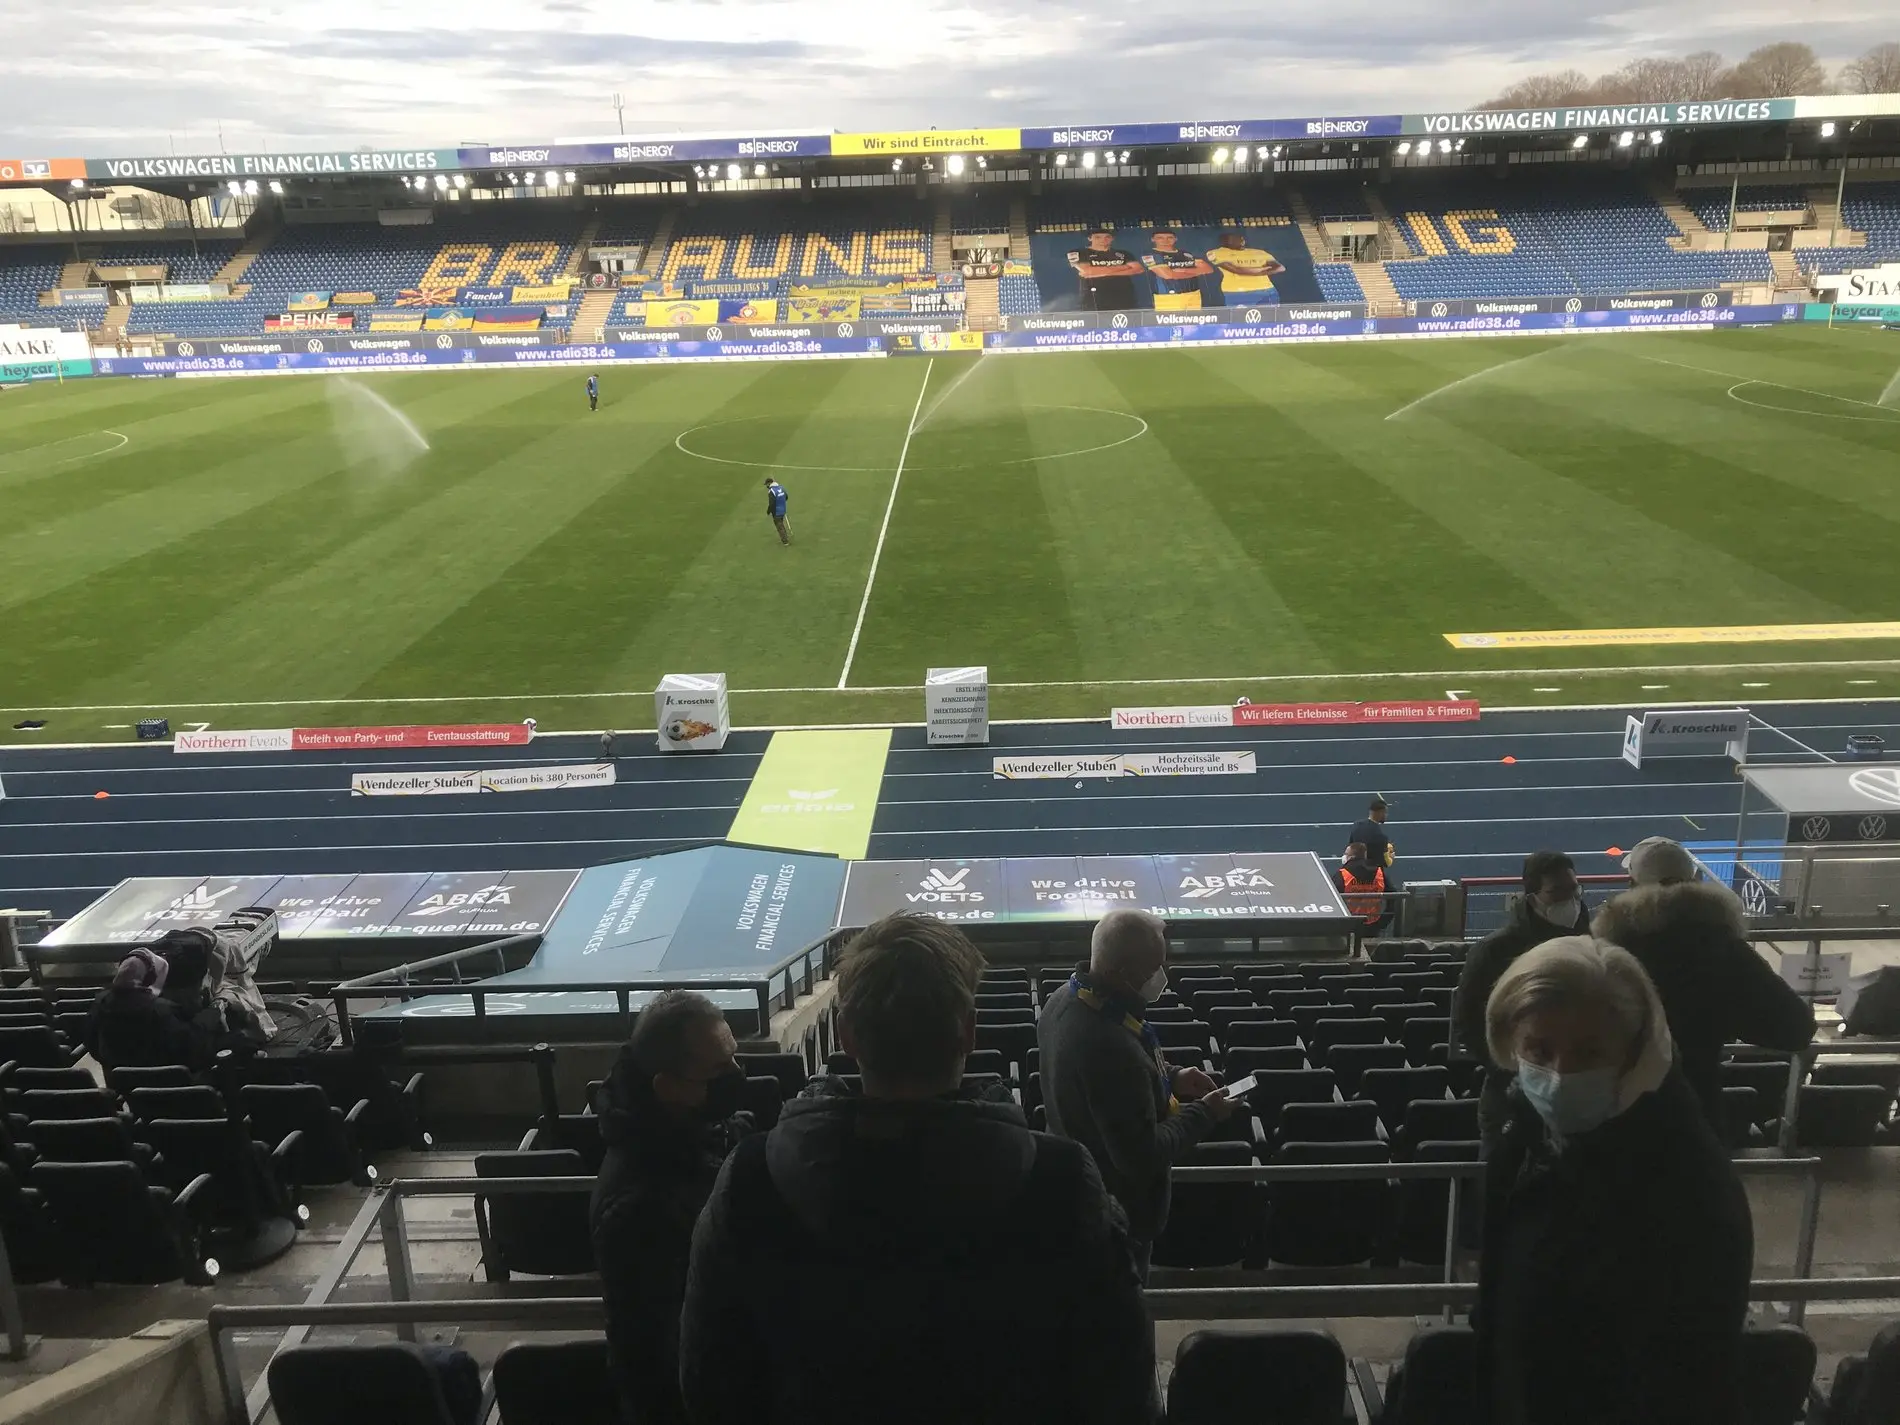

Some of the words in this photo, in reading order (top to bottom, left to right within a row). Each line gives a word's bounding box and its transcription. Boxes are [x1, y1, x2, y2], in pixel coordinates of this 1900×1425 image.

[1423, 111, 1556, 132] VOLKSWAGEN
[1564, 106, 1670, 127] FINANCIAL
[1676, 101, 1771, 122] SERVICES
[863, 137, 886, 149] Wir
[891, 136, 918, 148] sind
[924, 135, 988, 147] Eintracht.
[106, 157, 236, 177] VOLKSWAGEN
[243, 154, 344, 173] FINANCIAL
[350, 151, 437, 170] SERVICES
[465, 291, 504, 300] Fanclub
[911, 294, 941, 304] Unser
[1476, 302, 1537, 314] Volkswagen
[1611, 299, 1673, 310] Volkswagen
[280, 313, 338, 326] PEINE
[1156, 314, 1217, 325] Volkswagen
[1290, 309, 1351, 320] Volkswagen
[1630, 309, 1735, 324] www.radio38.de
[881, 323, 941, 335] Volkswagen
[1024, 318, 1084, 330] Volkswagen
[1418, 317, 1520, 331] www.radio38.de
[619, 331, 680, 342] Volkswagen
[750, 327, 810, 338] Volkswagen
[1036, 330, 1137, 344] www.radio38.de
[1224, 324, 1326, 338] www.radio38.de
[350, 339, 410, 350] Volkswagen
[479, 335, 540, 346] Volkswagen
[721, 340, 822, 354] www.radio38.de
[220, 343, 281, 354] Volkswagen
[515, 346, 616, 360] www.radio38.de
[143, 357, 244, 370] www.radio38.de
[327, 353, 427, 366] www.radio38.de
[1116, 711, 1185, 726] Northern
[1188, 709, 1228, 723] Events
[1241, 709, 1260, 720] Wir
[1262, 708, 1294, 720] liefern
[1297, 707, 1348, 719] Erlebnisse
[1364, 706, 1379, 717] für
[1381, 705, 1424, 717] Familien
[1426, 706, 1435, 716] &
[1438, 705, 1473, 716] Firmen
[179, 736, 246, 749] Northern
[250, 734, 288, 747] Events
[299, 734, 331, 744] Verleih
[334, 735, 351, 743] von
[354, 733, 382, 744] Party-
[385, 732, 404, 742] und
[427, 731, 510, 742] Eventausstattung
[1158, 753, 1221, 765] Hochzeitssäle
[1002, 762, 1074, 773] Wendezeller
[1076, 760, 1117, 772] Stuben
[1141, 765, 1150, 774] in
[1152, 764, 1204, 776] Wendeburg
[1206, 763, 1224, 773] und
[1227, 763, 1239, 772] BS
[360, 778, 431, 790] Wendezeller
[433, 777, 473, 788] Stuben
[488, 775, 528, 786] Location
[530, 774, 544, 784] bis
[546, 773, 563, 783] 380
[566, 771, 607, 781] Personen
[1031, 879, 1066, 889] We
[1074, 877, 1136, 888] drive
[1180, 873, 1276, 889] ABRA
[606, 868, 641, 911] FINANCIAL
[1036, 889, 1137, 900] Football
[279, 897, 314, 907] We
[320, 895, 382, 906] drive
[418, 891, 511, 906] ABRA
[736, 873, 769, 930] VOLKSWAGEN
[905, 891, 985, 903] VOETS
[615, 877, 657, 935] VOLKSWAGEN
[756, 903, 784, 950] FINANCIAL
[772, 864, 796, 901] SERVICES
[144, 909, 223, 921] VOETS
[348, 920, 540, 935] abra-querum.de
[583, 911, 617, 955] SERVICES
